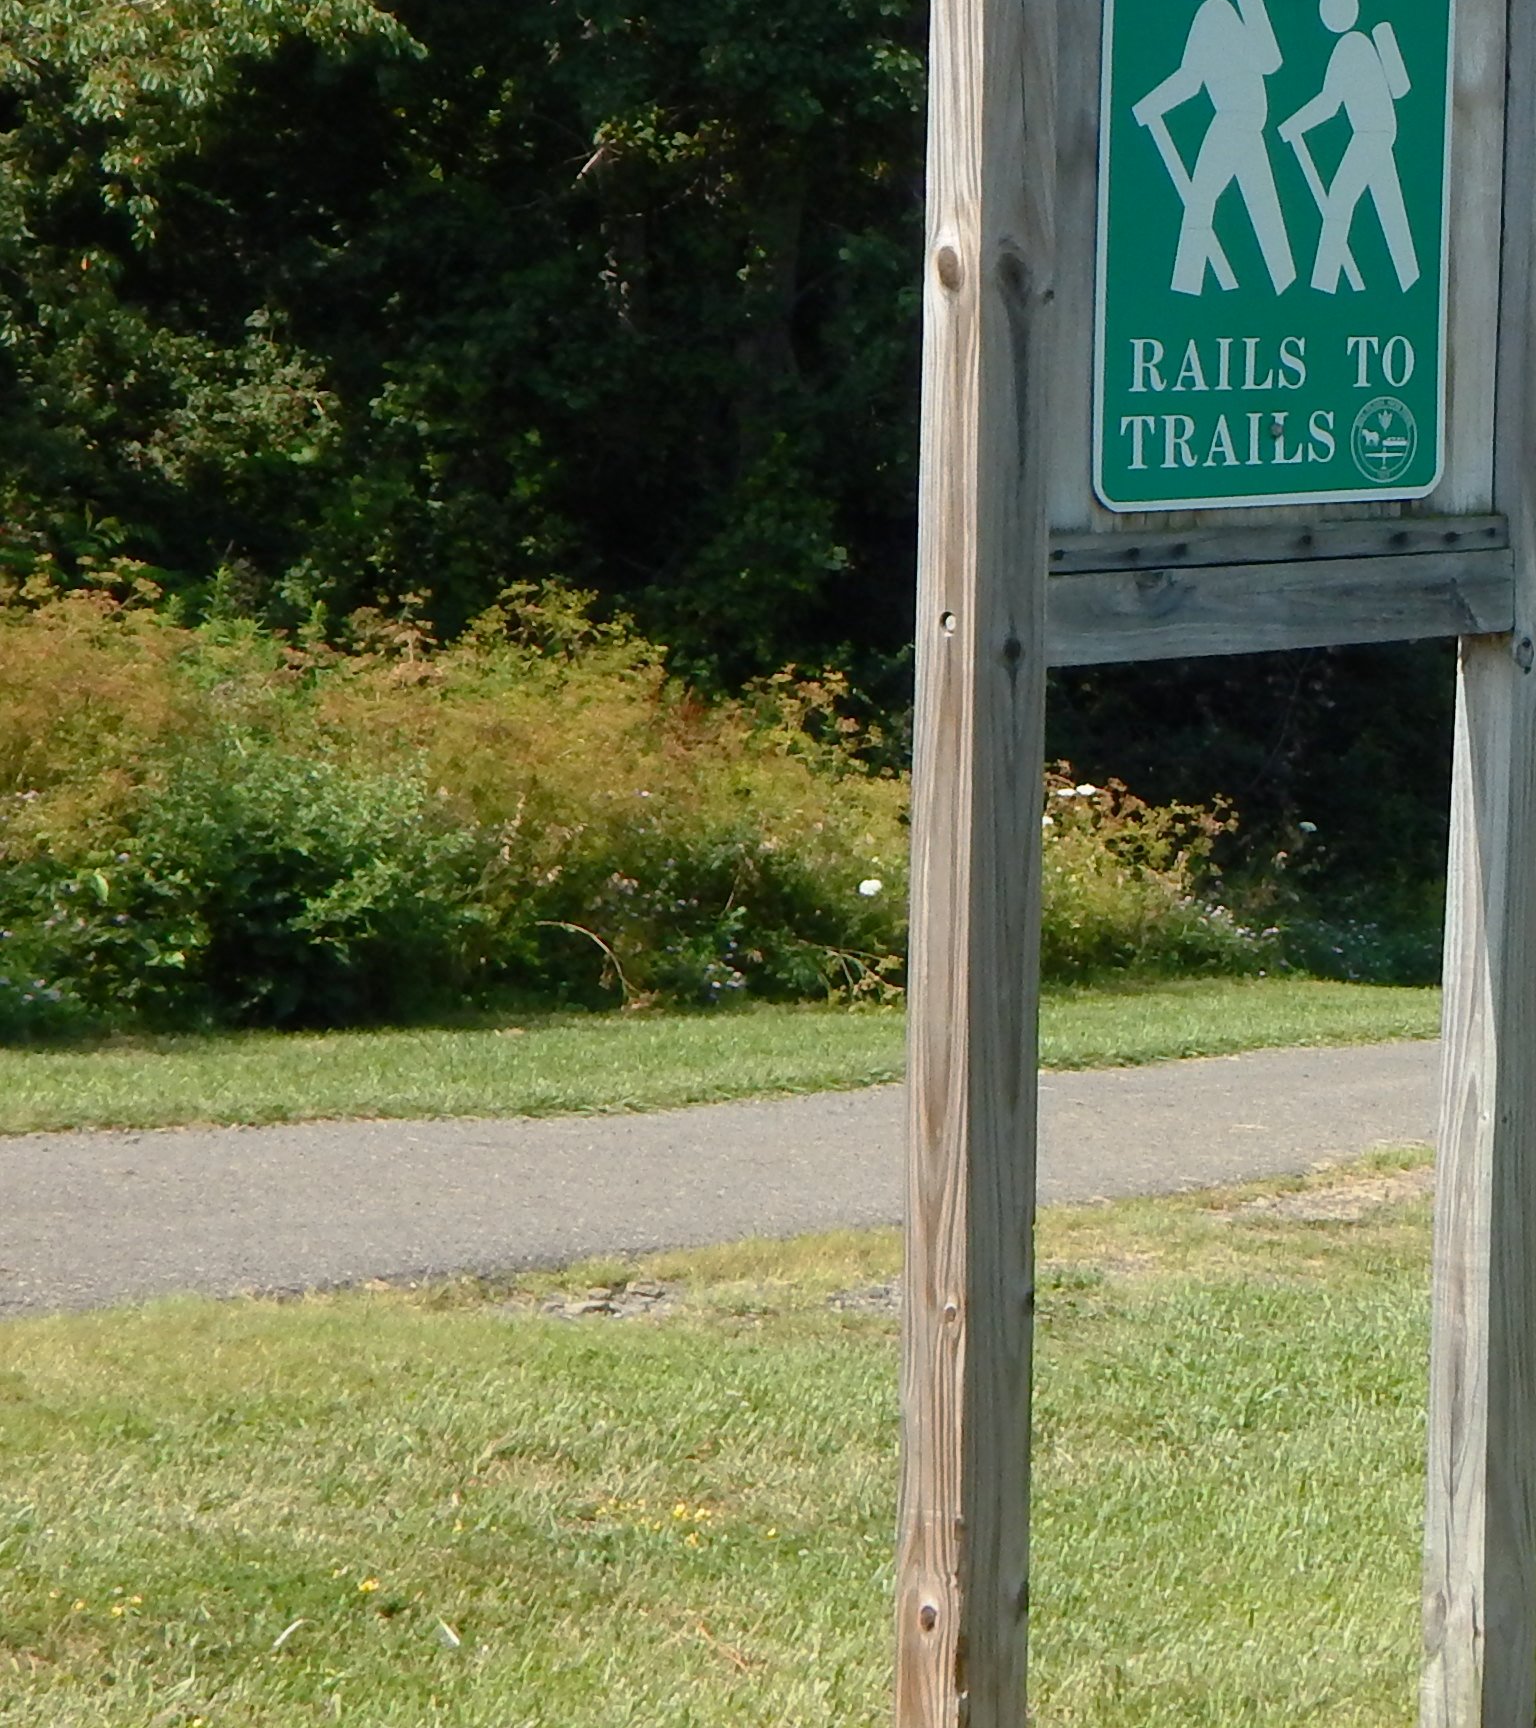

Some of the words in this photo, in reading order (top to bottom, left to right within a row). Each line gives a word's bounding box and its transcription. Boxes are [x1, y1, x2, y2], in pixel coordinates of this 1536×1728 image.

[1128, 336, 1307, 392] RAILS
[1346, 334, 1416, 388] TO
[1120, 410, 1336, 469] TRAILS
